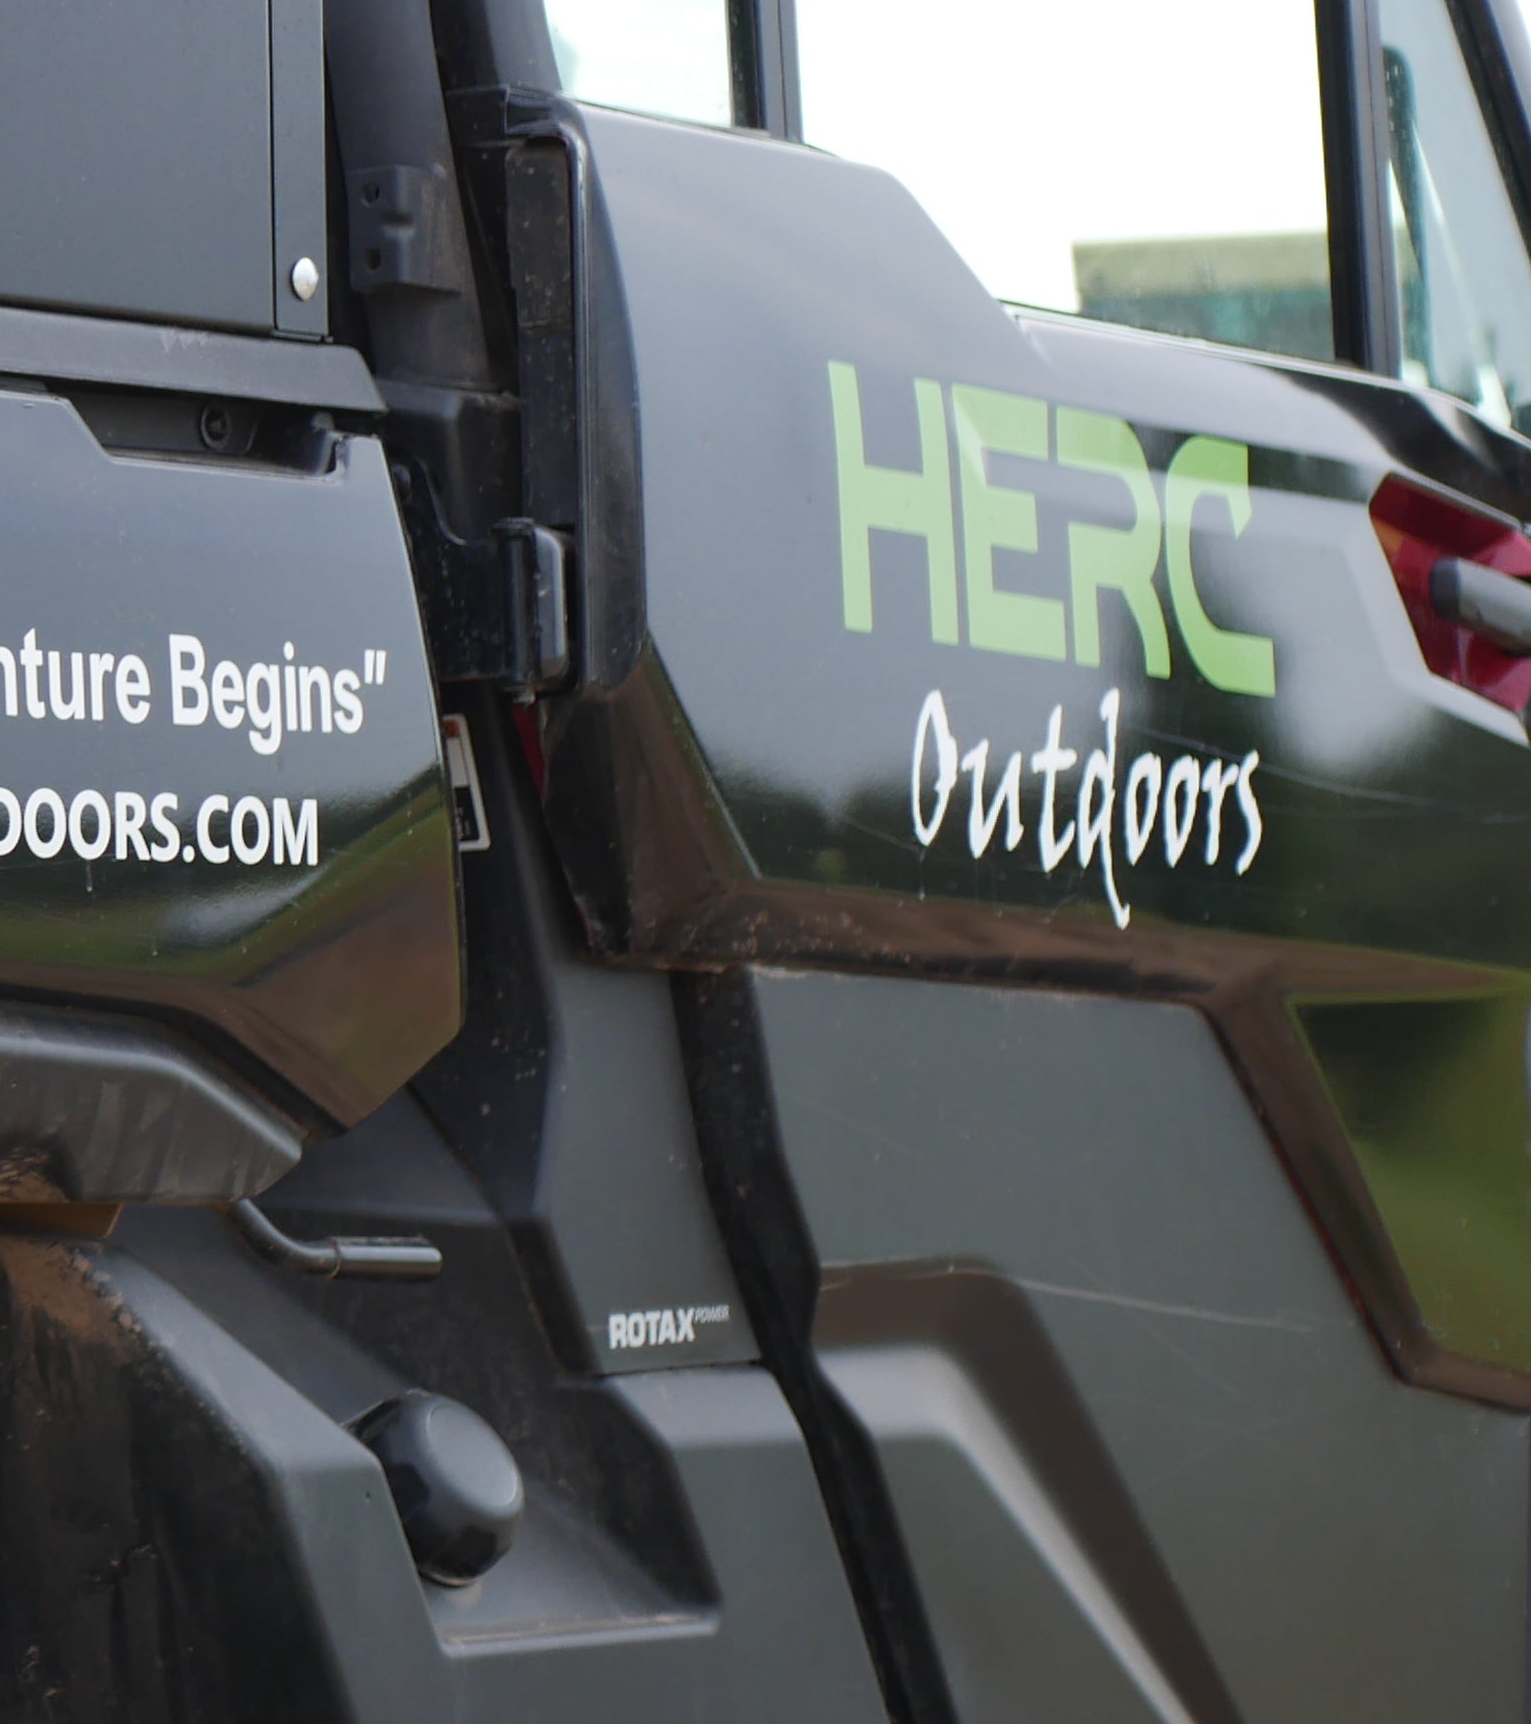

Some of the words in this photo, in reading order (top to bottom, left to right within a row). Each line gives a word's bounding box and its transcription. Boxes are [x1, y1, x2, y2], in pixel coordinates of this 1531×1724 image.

[828, 360, 1276, 698] HERC
[168, 633, 387, 756] Begins"
[910, 686, 1263, 930] Outdoors
[608, 1307, 696, 1350] ROTAX
